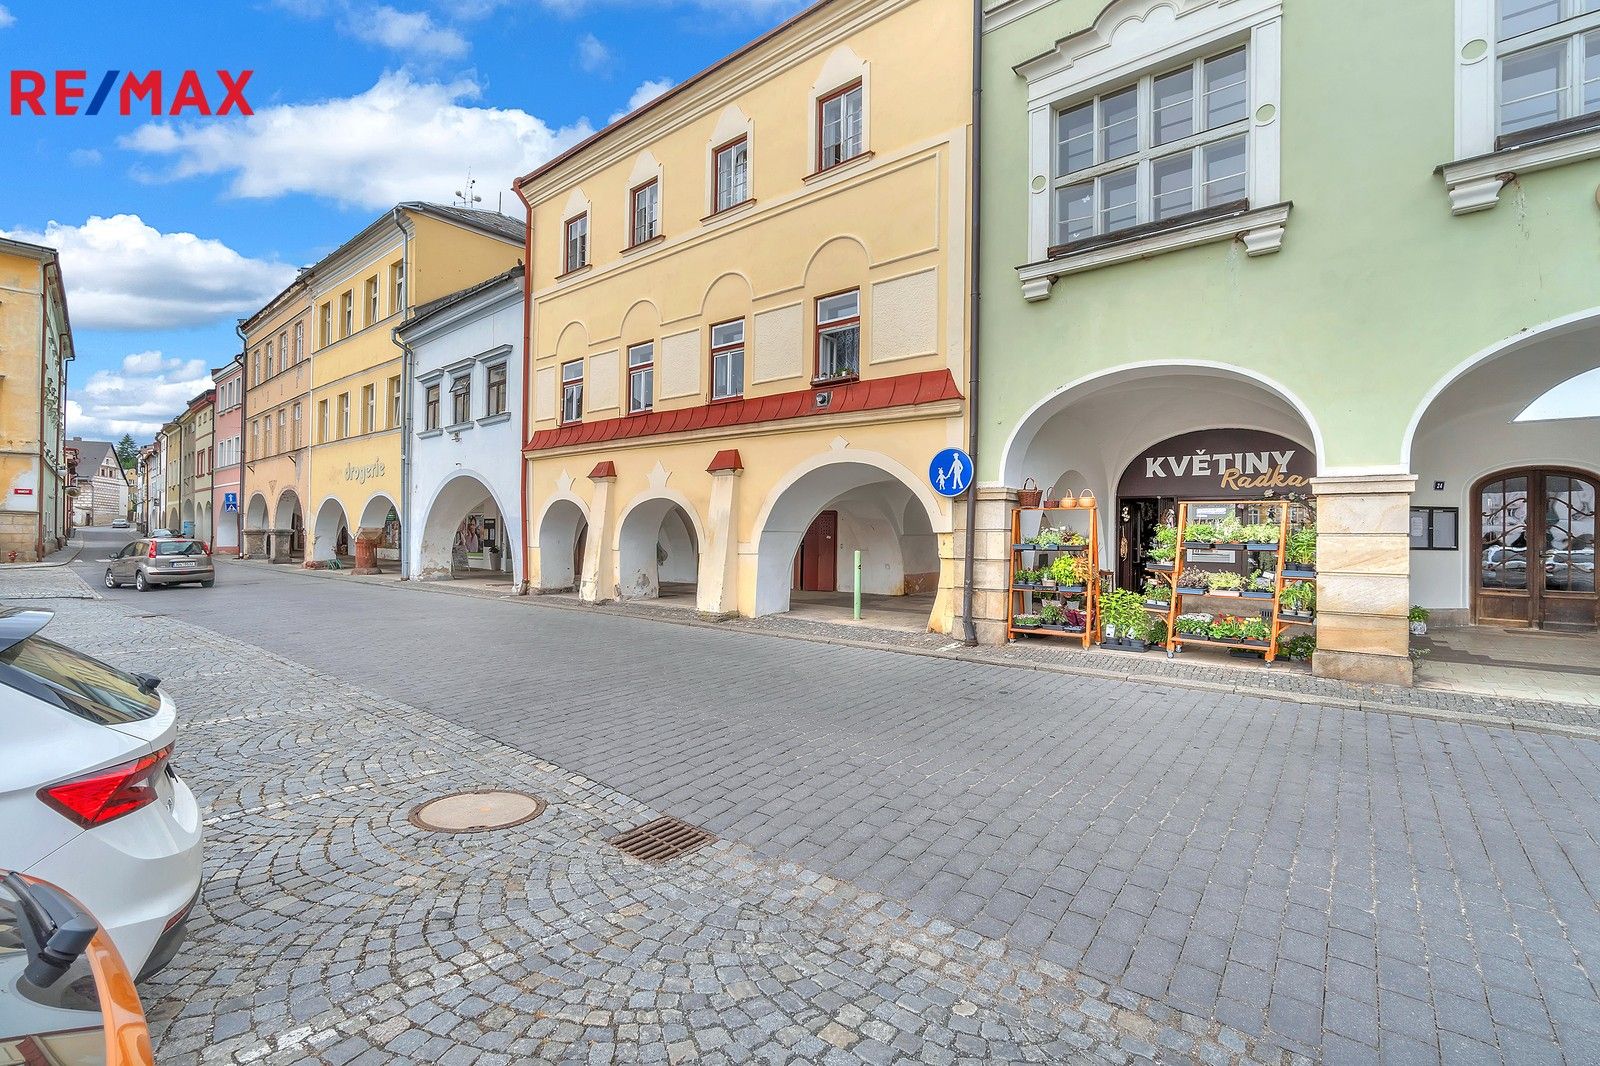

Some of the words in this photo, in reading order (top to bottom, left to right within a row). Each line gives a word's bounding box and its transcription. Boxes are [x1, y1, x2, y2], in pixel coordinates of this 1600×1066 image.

[345, 457, 385, 484] drogerie
[1145, 449, 1296, 477] KVĚTINY
[1220, 464, 1309, 490] Radka
